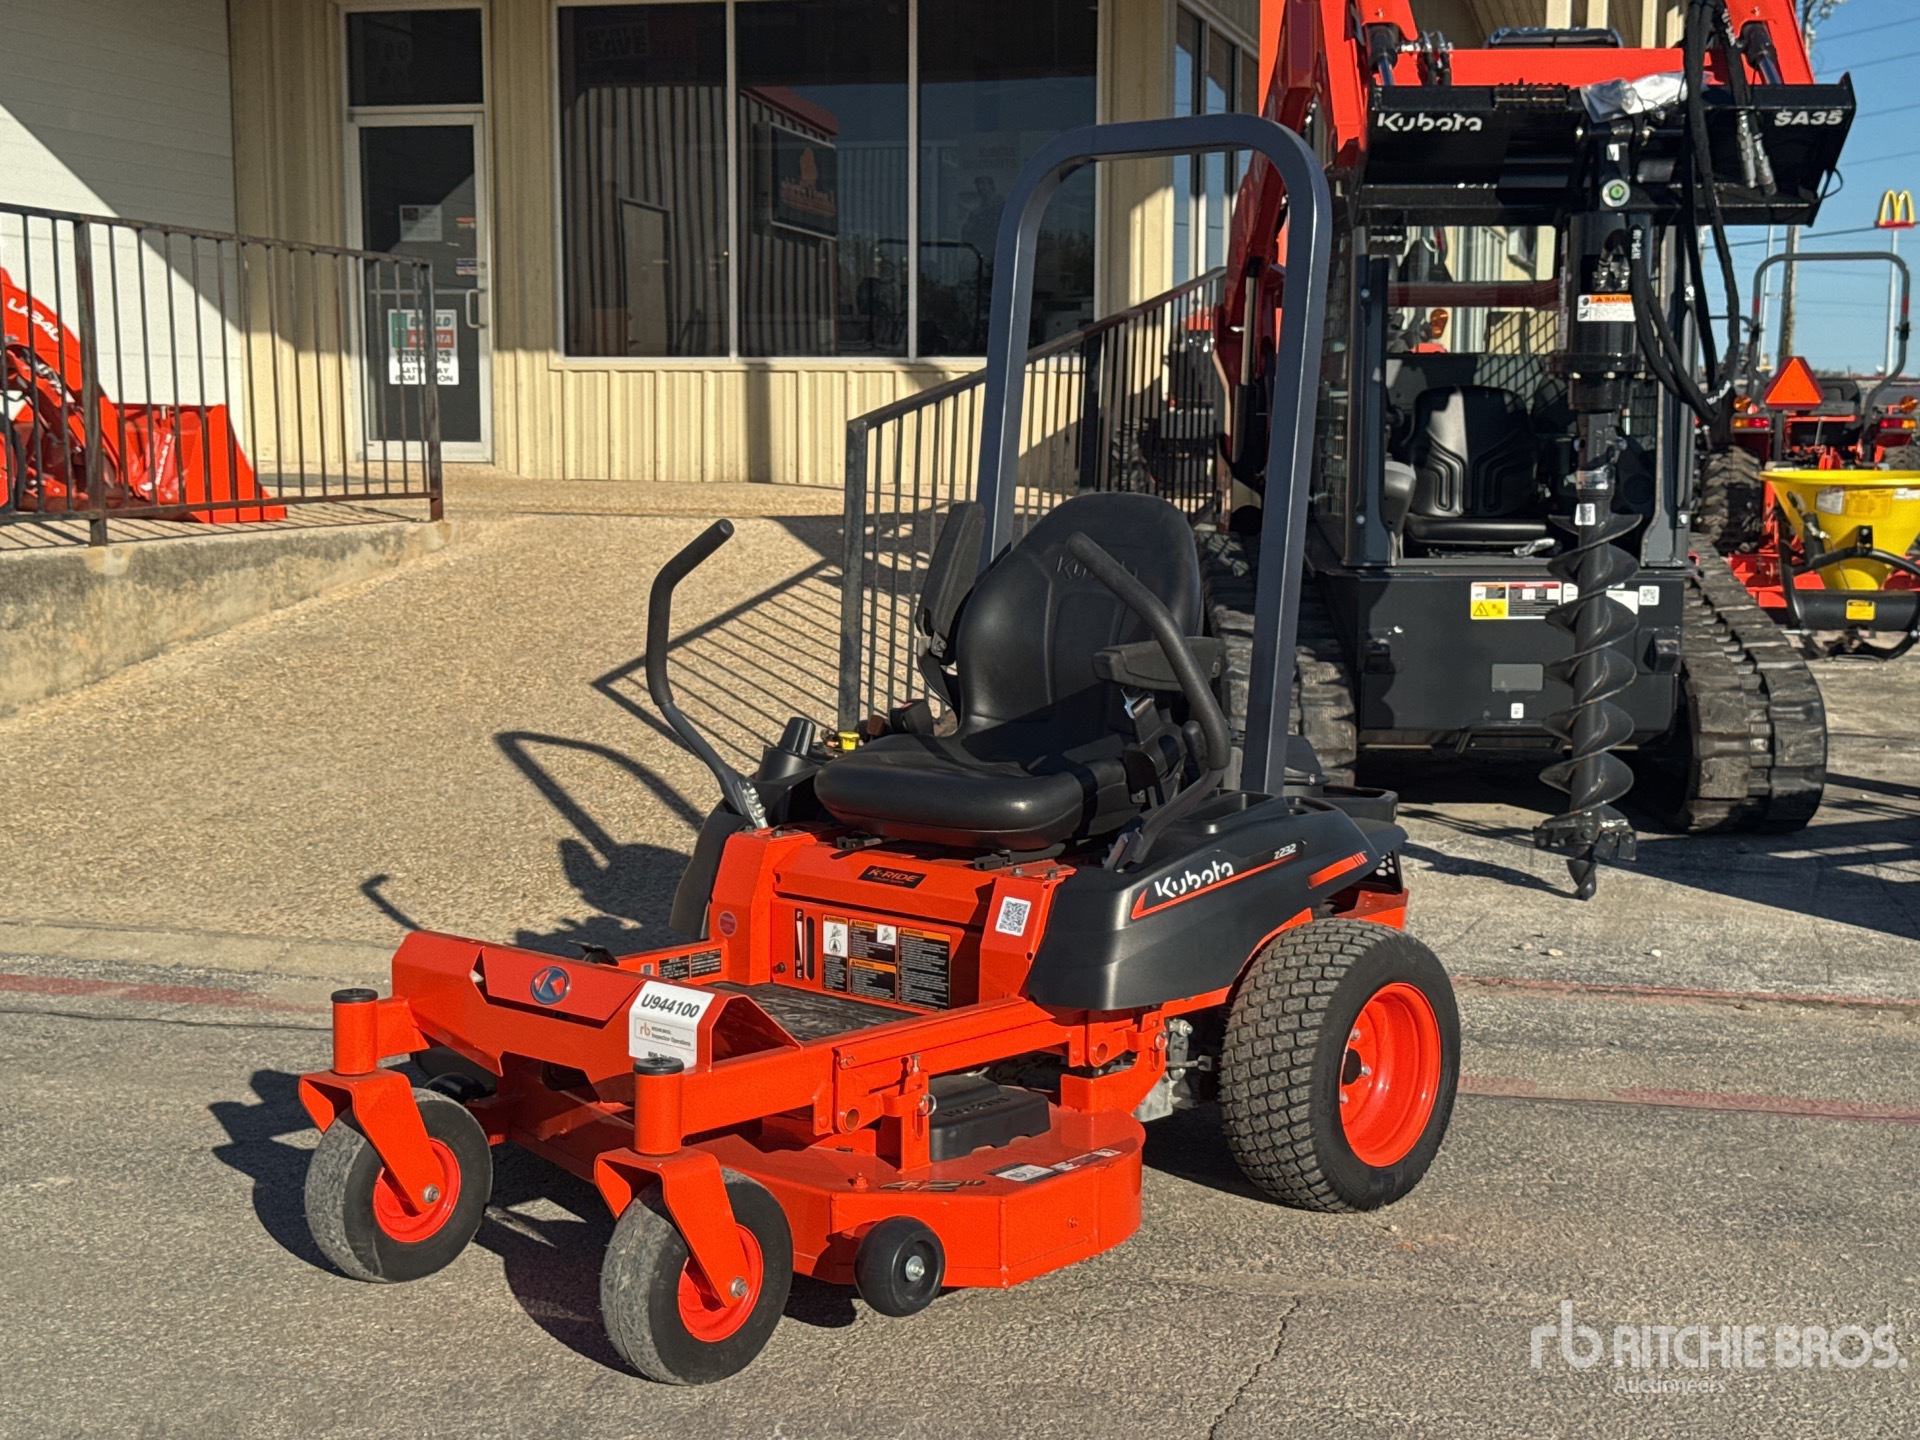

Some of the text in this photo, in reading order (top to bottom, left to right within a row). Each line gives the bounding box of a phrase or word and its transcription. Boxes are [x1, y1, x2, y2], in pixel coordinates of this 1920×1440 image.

[1377, 112, 1482, 131] Kubota
[1774, 110, 1843, 126] SA35
[1154, 860, 1235, 898] Kubota
[641, 993, 700, 1018] U944100
